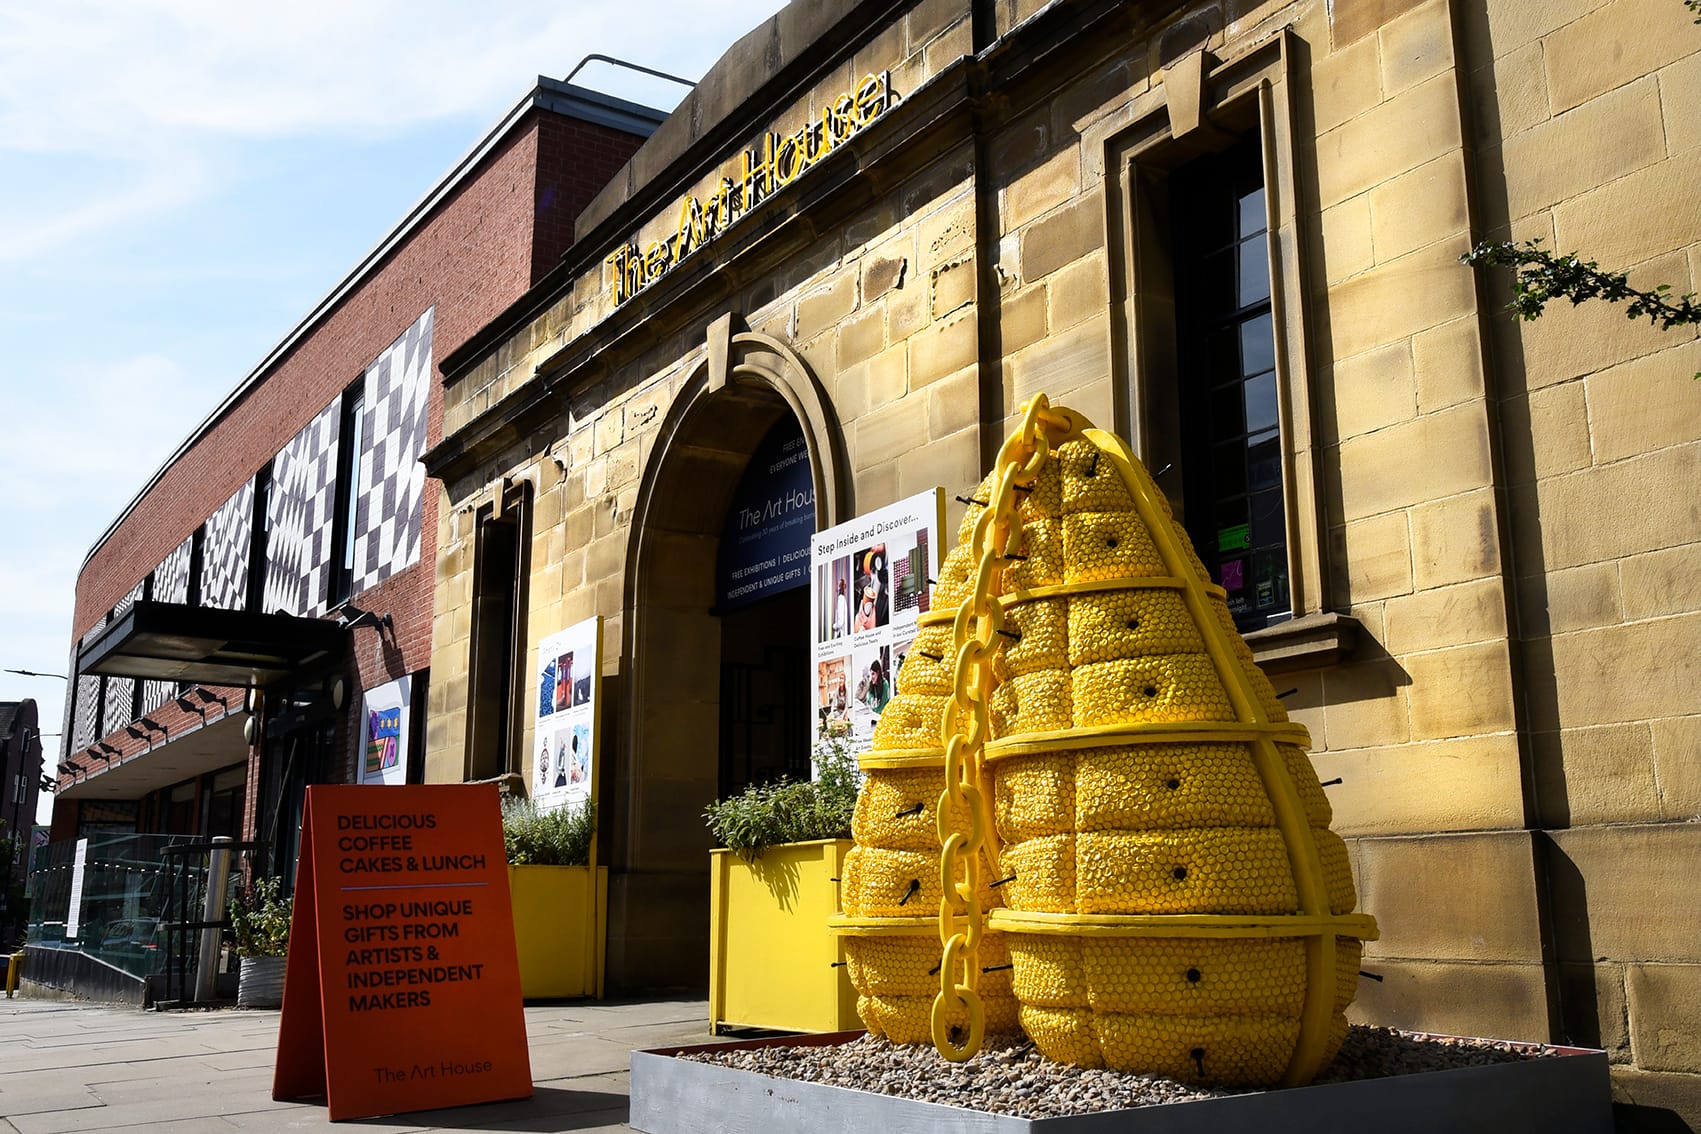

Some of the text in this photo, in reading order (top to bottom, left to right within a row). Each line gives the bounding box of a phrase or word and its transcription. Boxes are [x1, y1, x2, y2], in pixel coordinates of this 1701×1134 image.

[604, 72, 883, 307] The Art House
[739, 488, 815, 530] The Art Hou
[817, 543, 835, 556] Step
[836, 533, 859, 549] Inside
[860, 525, 875, 541] and
[732, 569, 744, 580] FREE
[744, 558, 776, 577] EXHIBITIONS
[763, 573, 784, 587] UNIQUE
[784, 568, 801, 580] GIFTS
[337, 814, 437, 830] DELICIOUS
[338, 835, 413, 851] COFFEE
[339, 855, 487, 873] CAKES & LUNCH
[342, 900, 473, 921] SHOP UNIQUE
[344, 922, 460, 943] GIFTS FROM
[346, 945, 439, 966] ARTISTS &
[347, 964, 484, 989] INDEPENDENT
[349, 990, 431, 1012] MAKERS
[373, 1060, 493, 1084] The Art House
